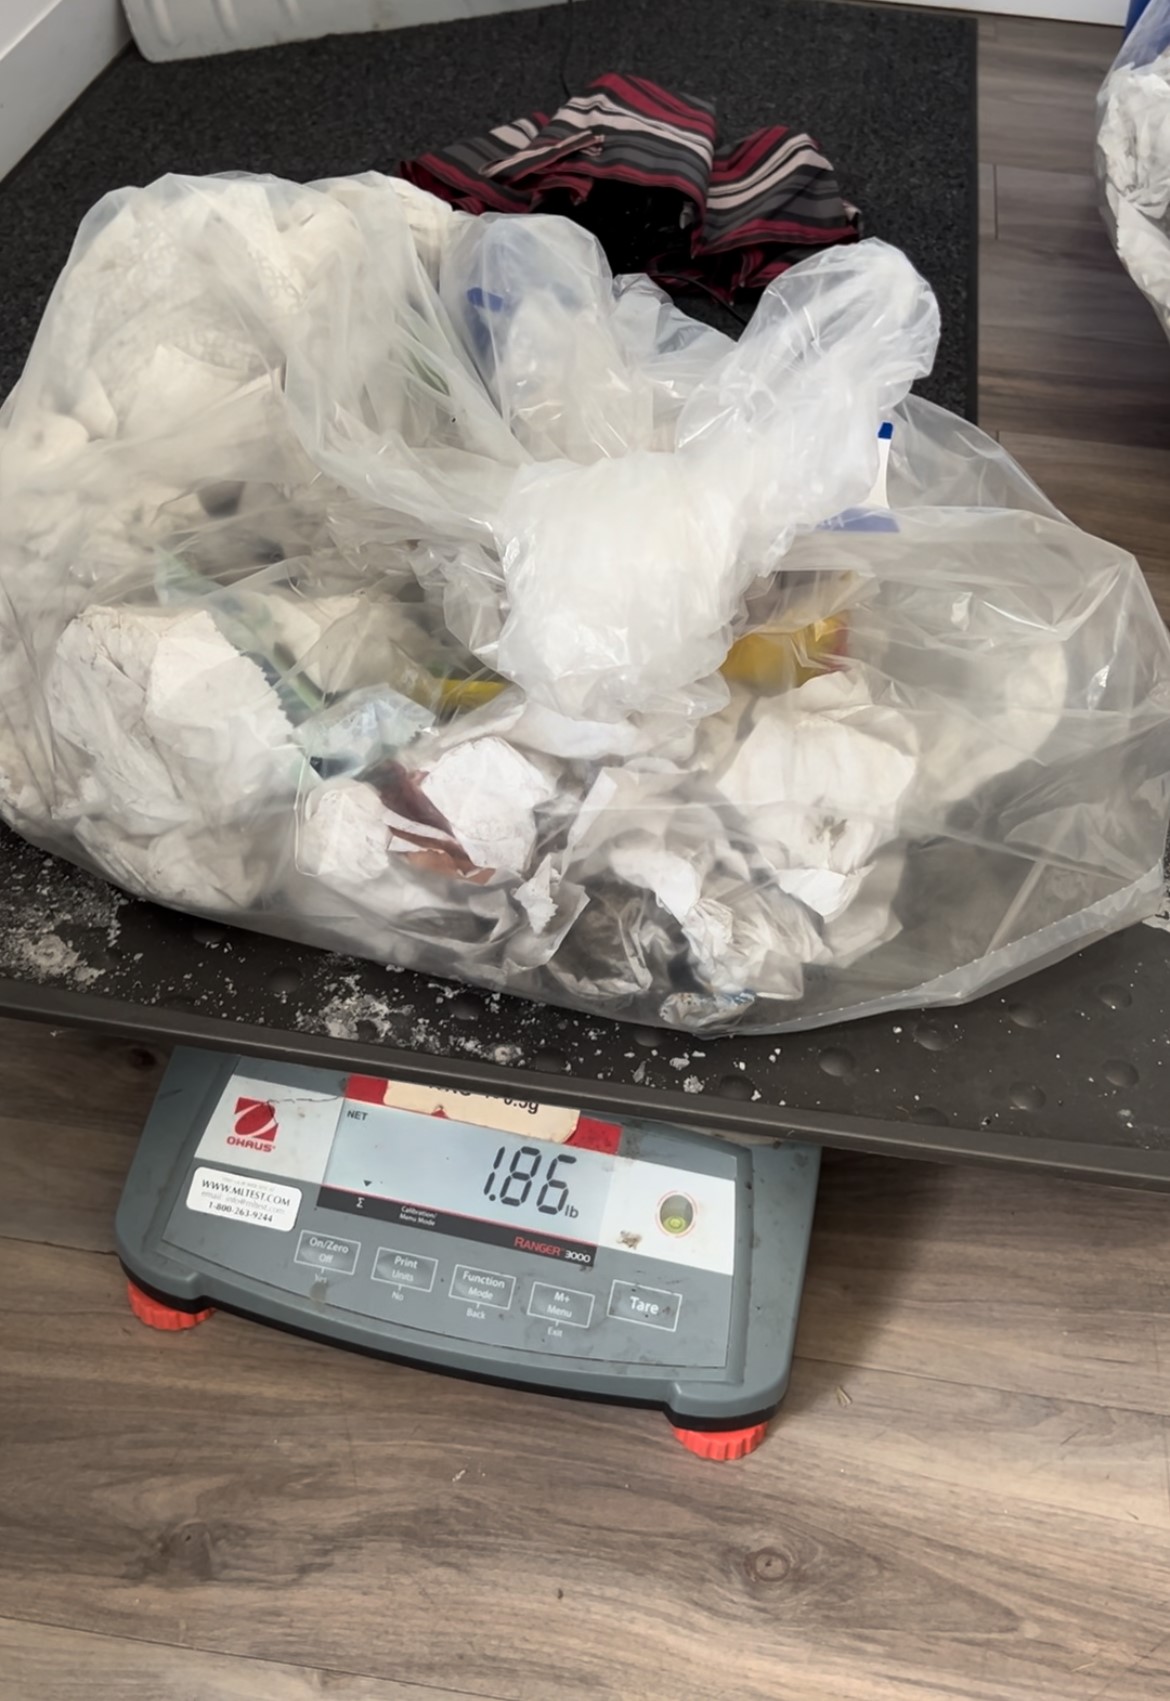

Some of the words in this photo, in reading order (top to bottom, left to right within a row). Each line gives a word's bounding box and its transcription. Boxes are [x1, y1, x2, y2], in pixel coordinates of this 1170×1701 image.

[347, 1109, 368, 1121] NET
[226, 1136, 272, 1153] OHAUS
[483, 1146, 577, 1215] 1.86
[564, 1204, 579, 1218] lb
[399, 1212, 417, 1222] Menu
[418, 1216, 436, 1226] Mode
[309, 1237, 350, 1254] On/Zero
[514, 1236, 561, 1256] RANGER
[564, 1250, 591, 1263] 3000
[319, 1253, 334, 1264] Off
[394, 1255, 418, 1269] Print
[391, 1269, 414, 1282] Units
[462, 1270, 506, 1289] Function
[391, 1291, 404, 1302] No
[468, 1286, 494, 1301] Mode
[554, 1291, 570, 1303] M+
[546, 1304, 572, 1318] Menu
[630, 1295, 660, 1315] Tare
[466, 1307, 485, 1320] Back
[547, 1326, 563, 1337] Exit
